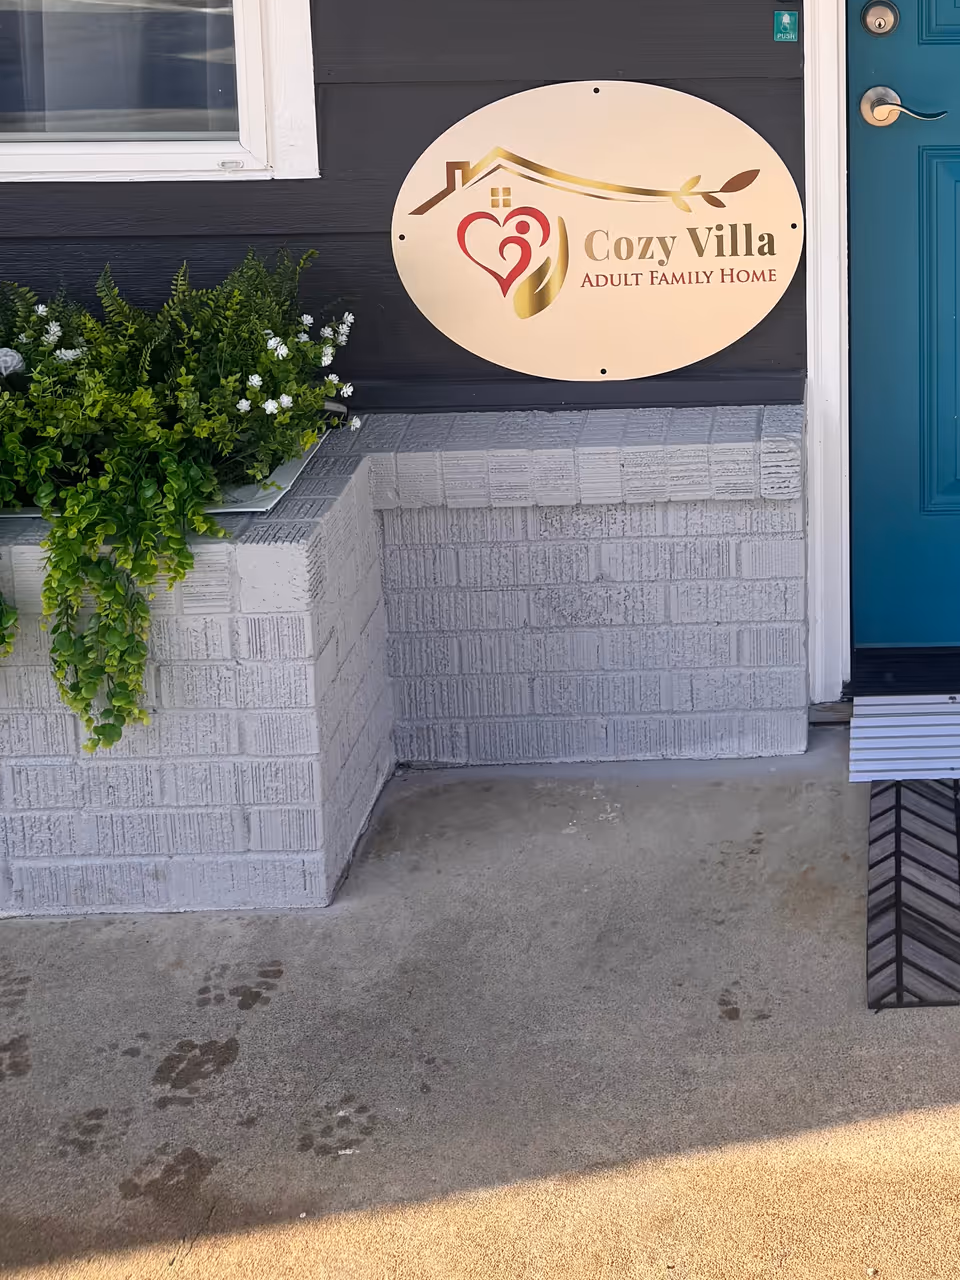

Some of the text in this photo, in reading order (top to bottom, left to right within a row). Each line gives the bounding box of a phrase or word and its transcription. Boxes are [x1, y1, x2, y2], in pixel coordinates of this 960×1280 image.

[584, 223, 777, 267] Cozy Villa
[580, 268, 777, 287] ADULT FAMILY HOME
